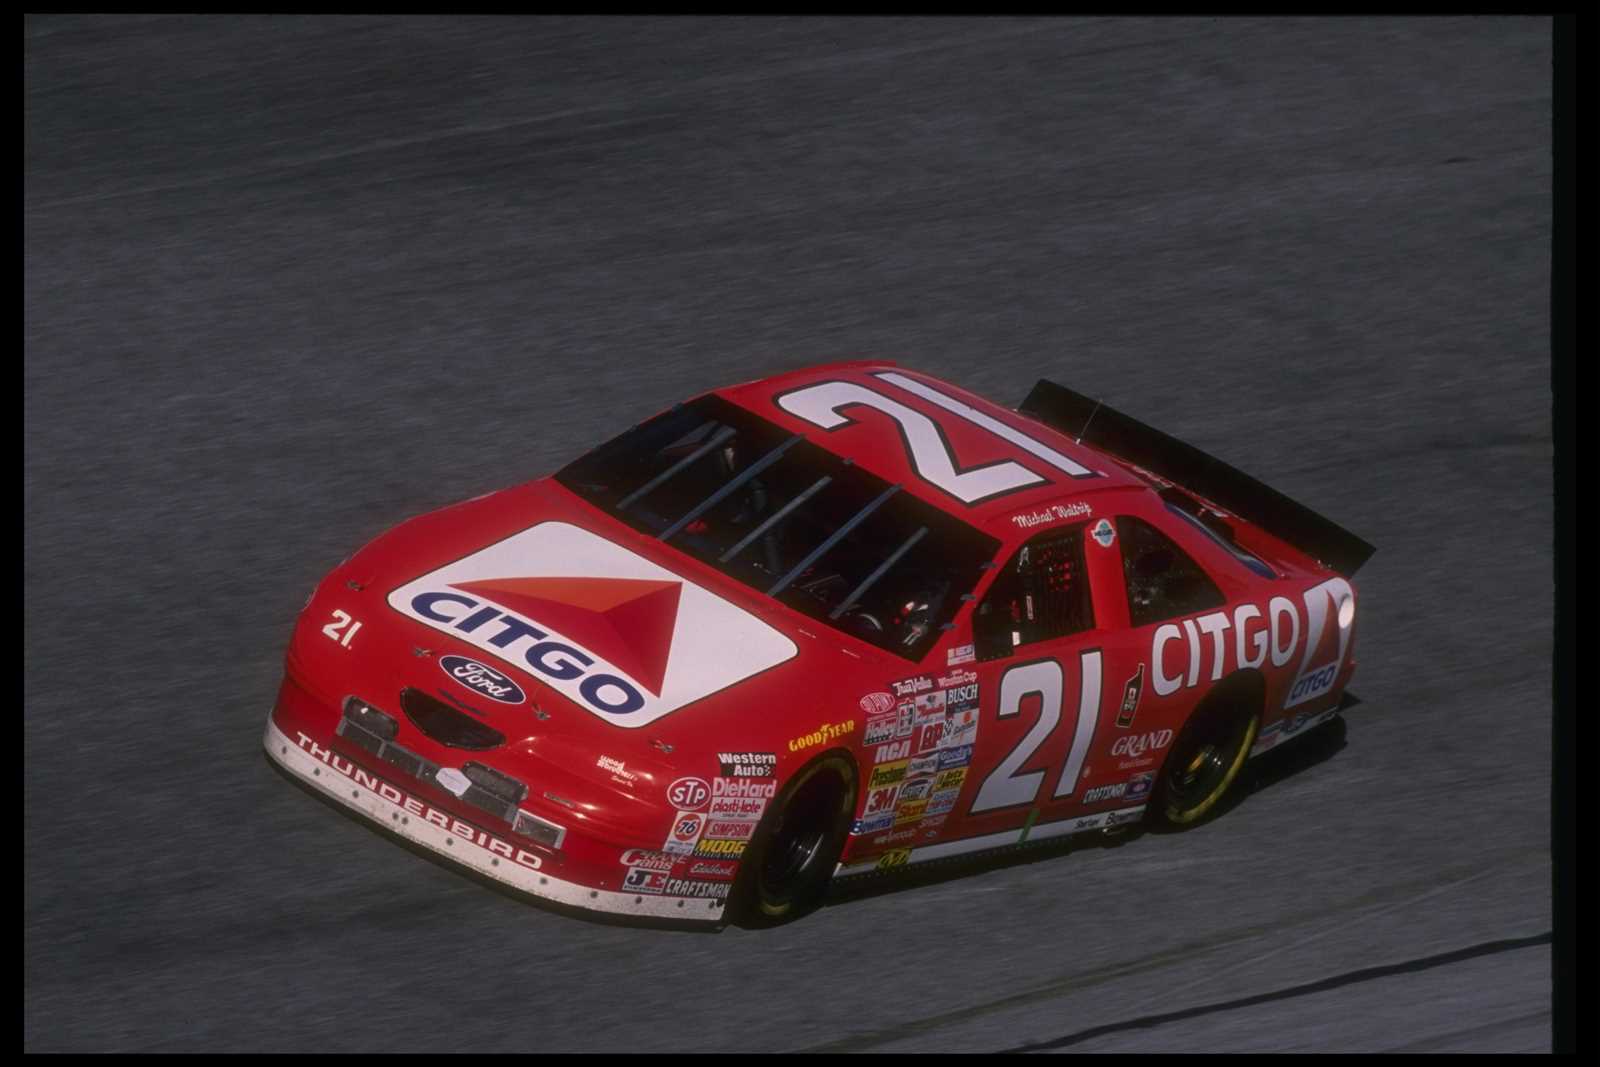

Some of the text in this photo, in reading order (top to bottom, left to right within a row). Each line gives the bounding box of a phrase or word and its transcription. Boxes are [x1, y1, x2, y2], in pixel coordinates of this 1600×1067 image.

[777, 371, 1095, 504] 21
[321, 608, 362, 648] 21
[410, 591, 646, 715] CITGO
[1152, 596, 1299, 696] CITGO
[453, 662, 513, 698] Ford
[1290, 665, 1337, 700] CITGO
[947, 683, 978, 705] BUSCH
[788, 719, 855, 752] GOODYEAR
[970, 650, 1102, 814] 21
[1112, 729, 1172, 757] GRAND
[717, 752, 777, 764] Western
[733, 765, 764, 776] Auto
[296, 731, 544, 870] THUNDERBIRD
[672, 781, 706, 804] STP
[712, 777, 777, 797] DieHard
[867, 787, 897, 813] 3M
[677, 821, 697, 834] 76
[711, 821, 752, 838] SIMPSON
[697, 840, 748, 854] MOOG
[664, 878, 731, 899] CRAFTSMAN
